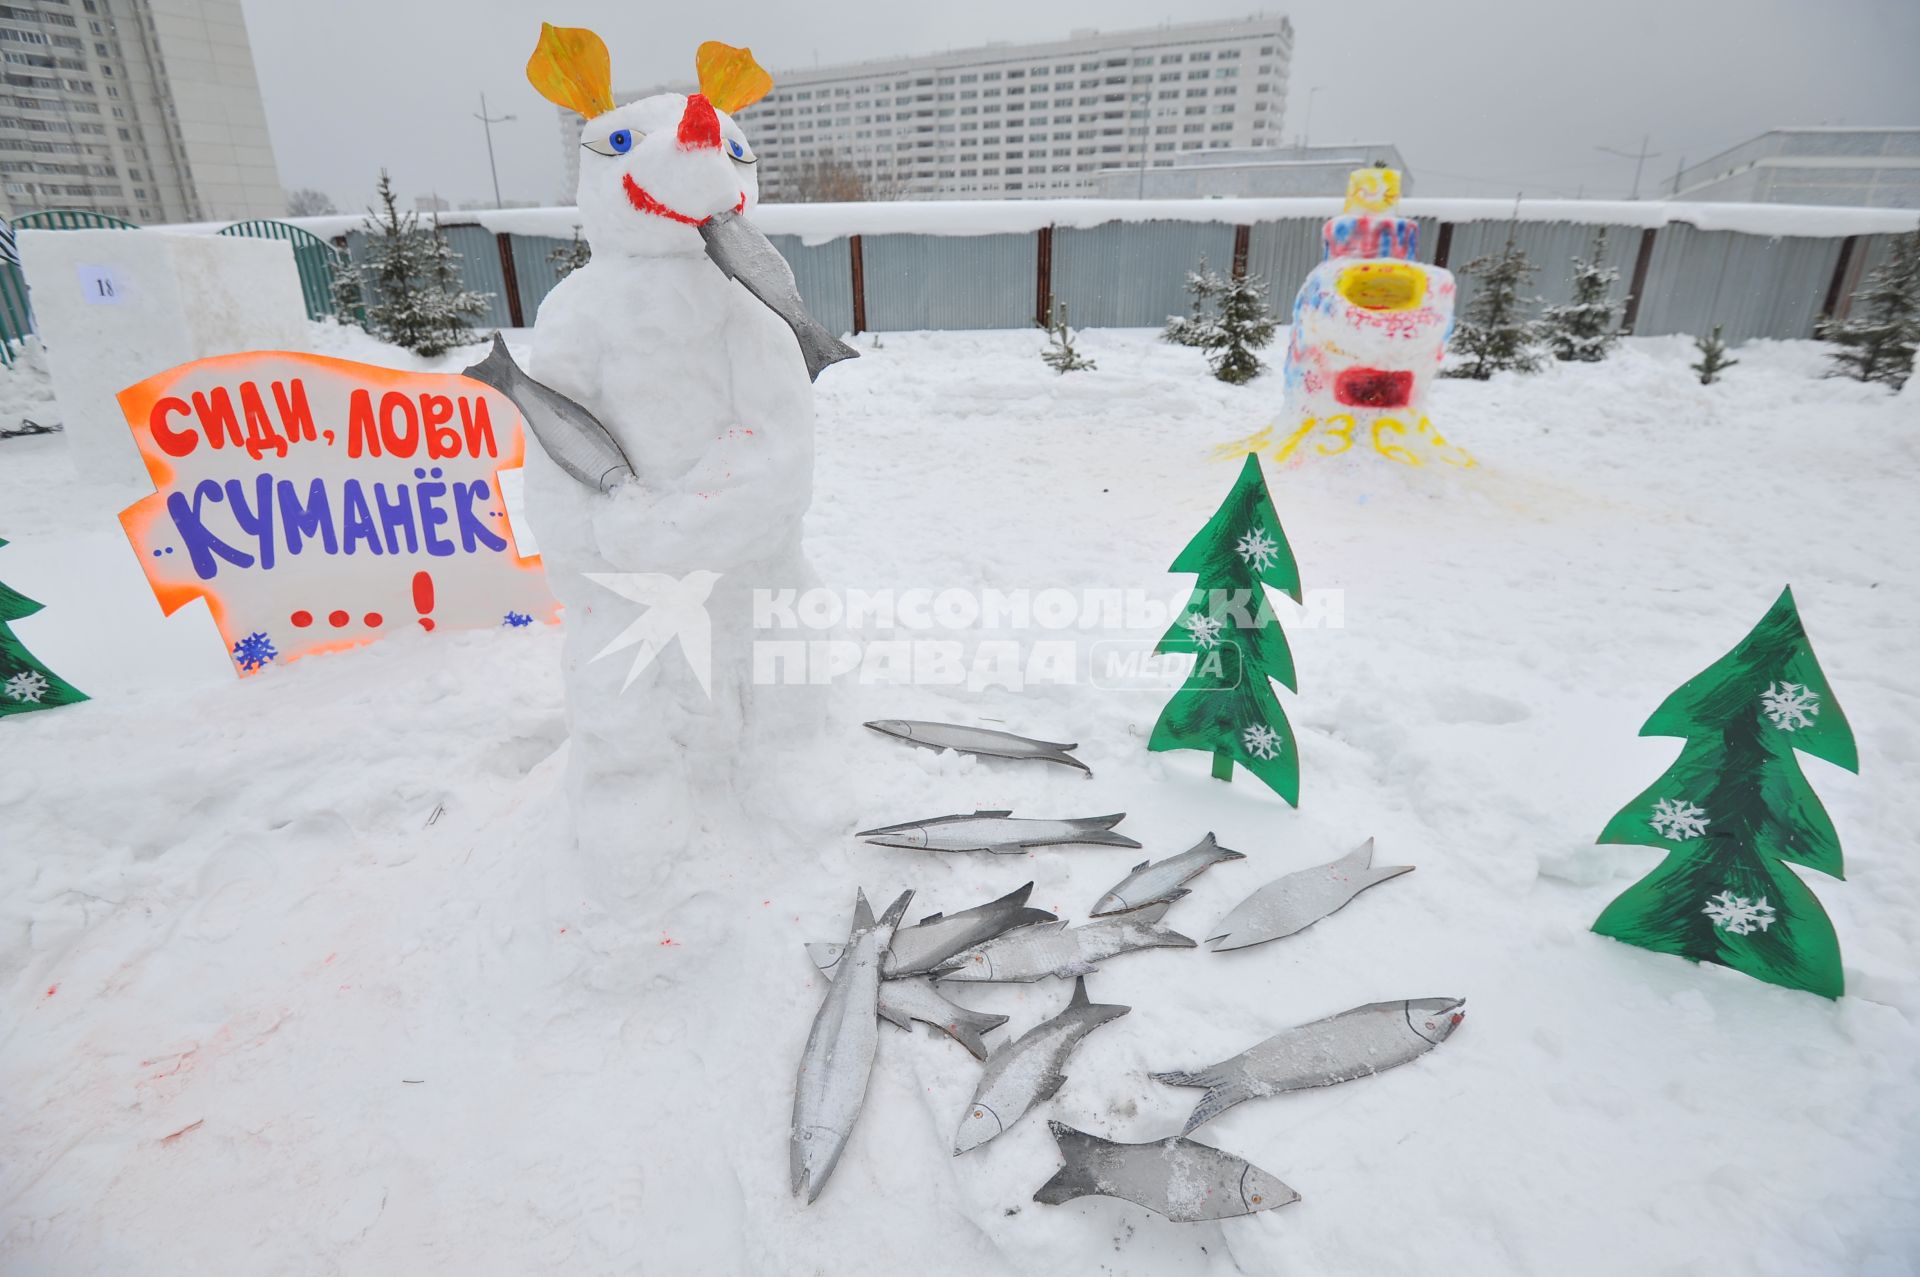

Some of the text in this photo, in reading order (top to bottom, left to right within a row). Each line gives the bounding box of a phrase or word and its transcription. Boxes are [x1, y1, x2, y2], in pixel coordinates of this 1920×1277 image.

[97, 279, 114, 297] 18
[149, 378, 498, 460] СИДИ, ЛОВИ
[166, 467, 508, 580] КУМАНЁК
